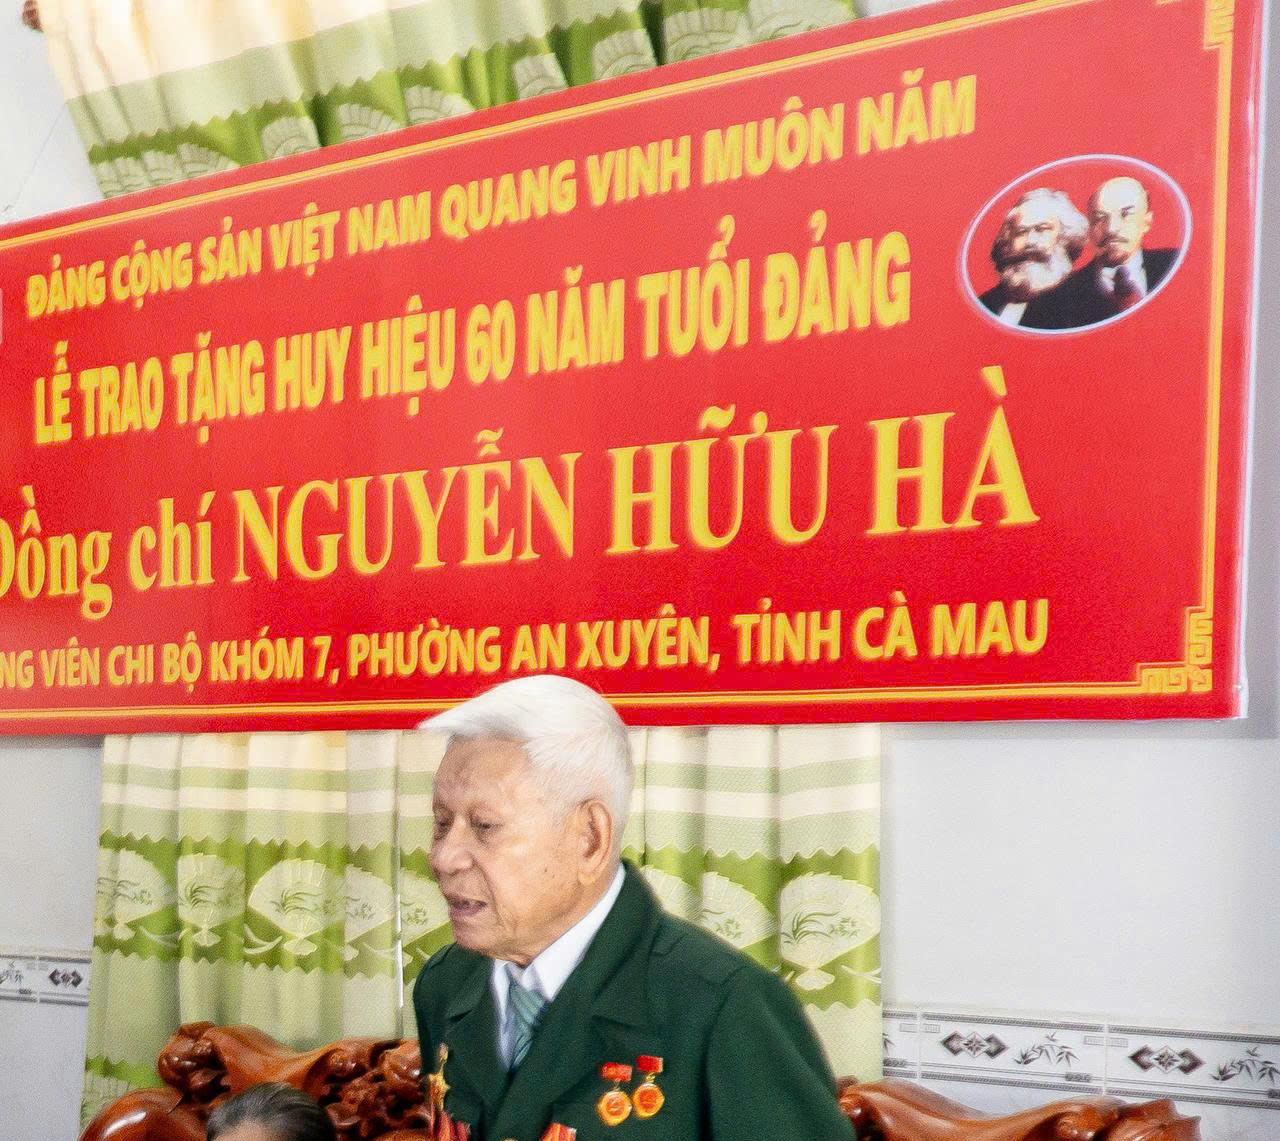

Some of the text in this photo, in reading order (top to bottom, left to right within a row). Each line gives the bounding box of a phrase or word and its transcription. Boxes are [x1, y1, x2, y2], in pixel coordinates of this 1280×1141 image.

[26, 68, 977, 318] ĐẢNG CỘNG SẢN VIỆT NAM QUANG VINH MUÔN NĂM
[35, 209, 911, 445] LỄ TRAO TẶNG HUY HIỆU 60 NĂM TUỔI ĐẢNG
[128, 491, 216, 591] chí
[232, 429, 581, 583] NGUYỄN
[607, 405, 838, 554] HỮU
[869, 365, 1040, 535] HÀ
[39, 637, 101, 688] VIÊN
[106, 644, 154, 686] CHI
[162, 631, 203, 692] BỘ
[210, 626, 304, 681] KHÓM
[313, 635, 339, 684] 7,
[349, 618, 501, 677] PHƯỜNG
[511, 623, 566, 671] AN
[576, 603, 721, 671] XUYÊN,
[733, 597, 841, 663] TỈNH
[854, 591, 918, 659] CÀ
[932, 599, 1049, 656] MAU
